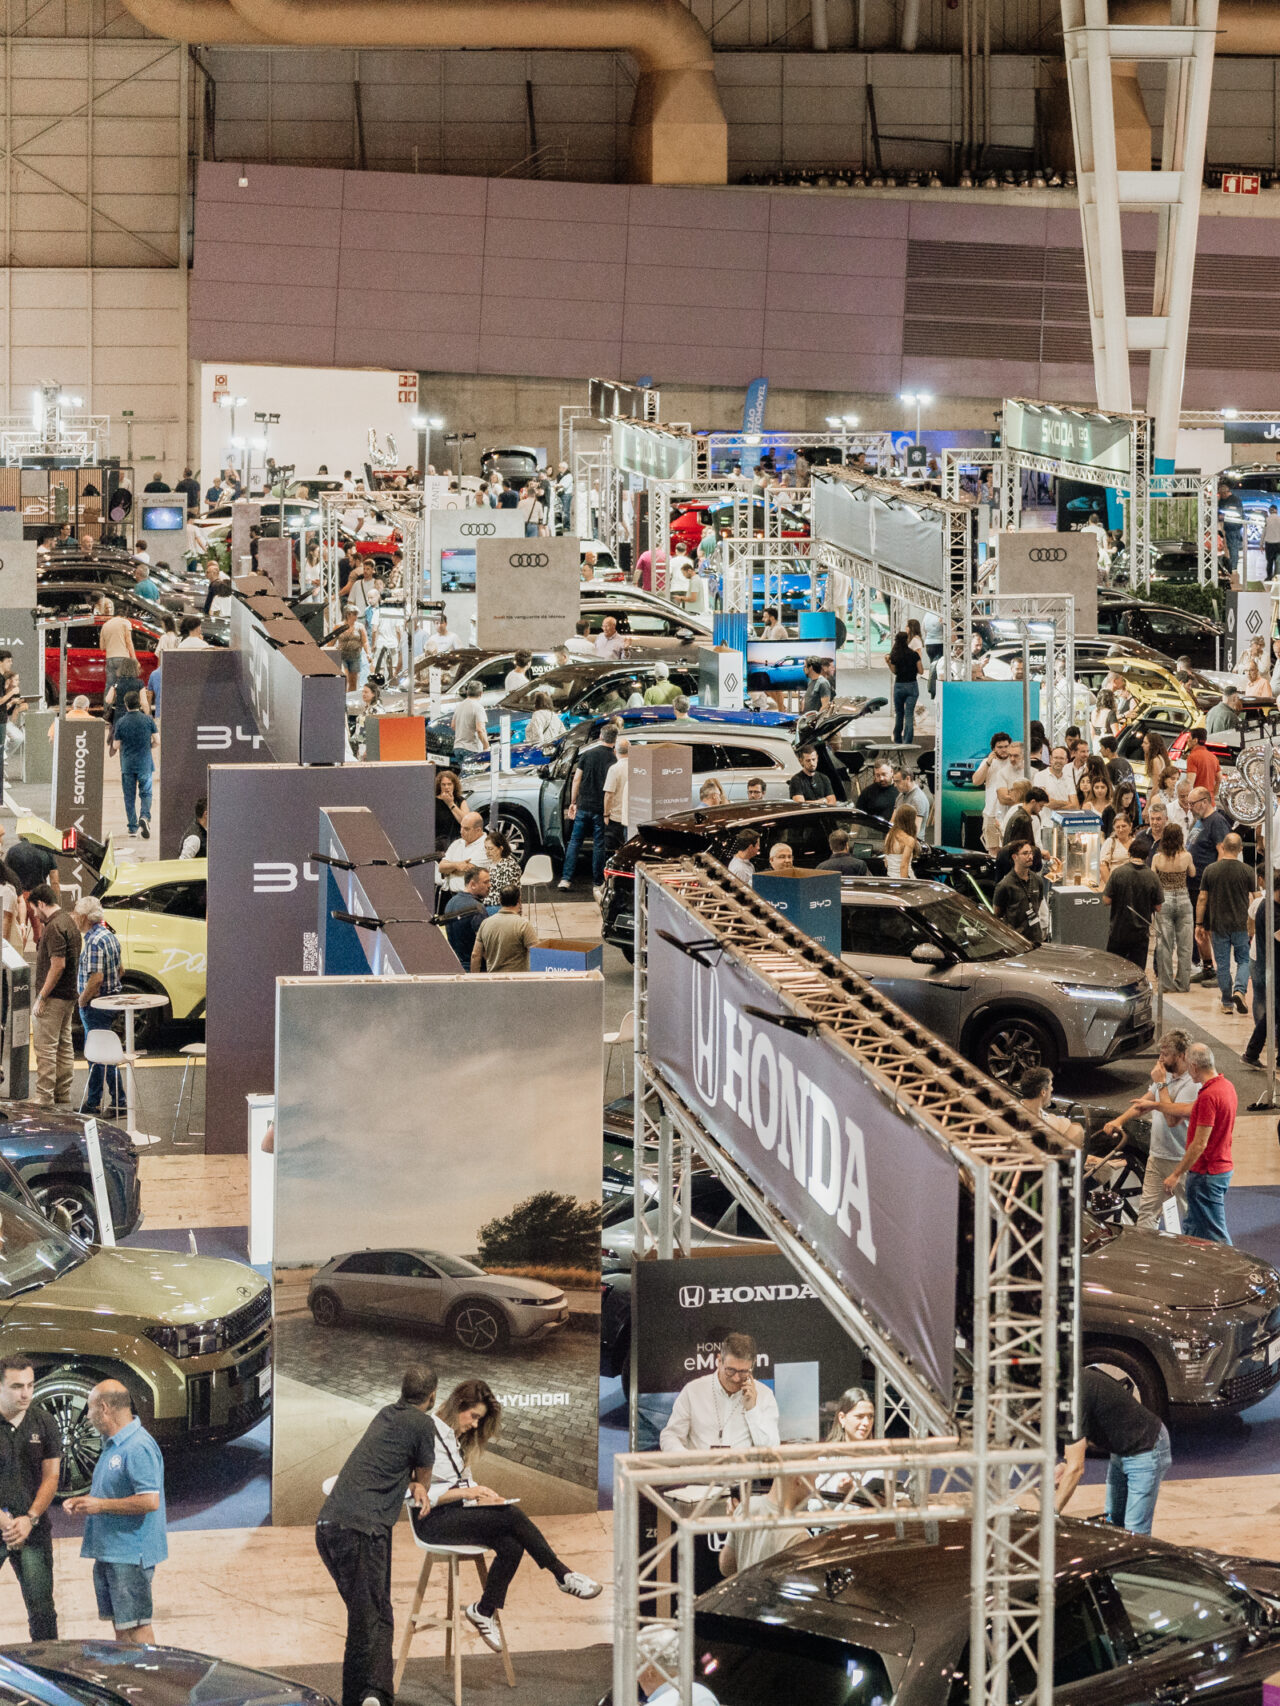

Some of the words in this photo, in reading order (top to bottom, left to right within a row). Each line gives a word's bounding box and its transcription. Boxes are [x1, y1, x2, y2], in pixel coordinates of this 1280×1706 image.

[766, 900, 788, 910] YD
[809, 899, 832, 909] BYD
[1074, 897, 1100, 906] BYD
[722, 999, 877, 1266] HONDA
[708, 1283, 820, 1304] HONDA
